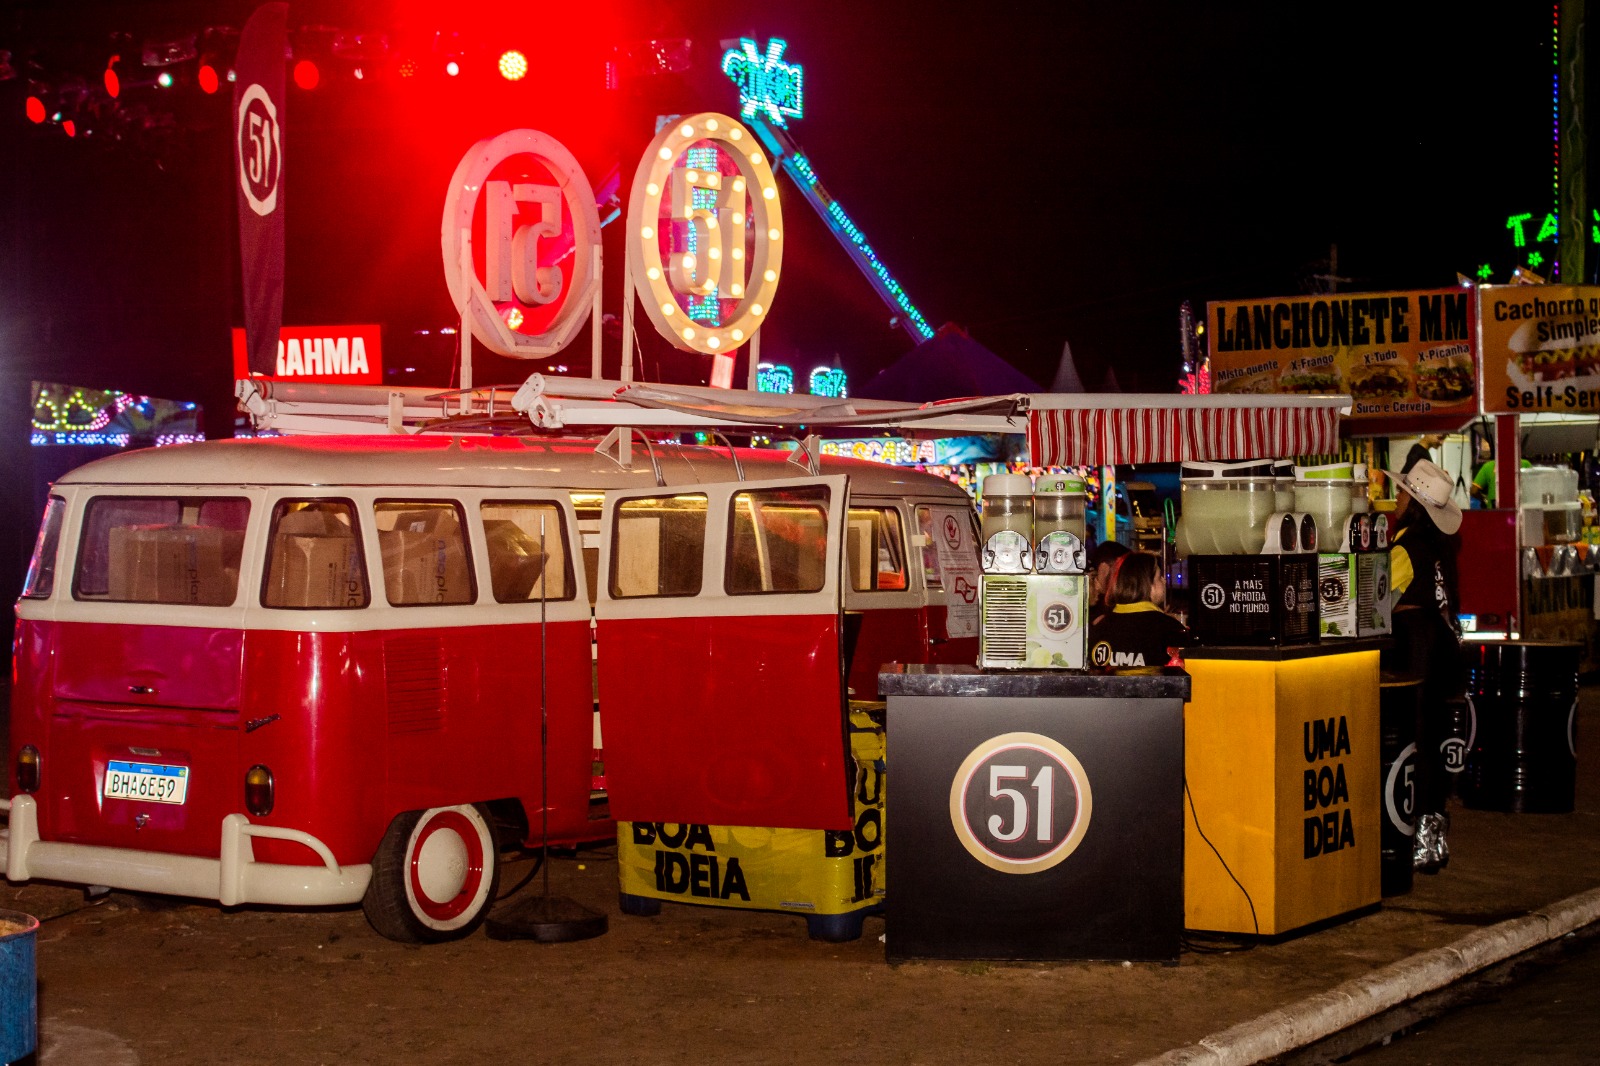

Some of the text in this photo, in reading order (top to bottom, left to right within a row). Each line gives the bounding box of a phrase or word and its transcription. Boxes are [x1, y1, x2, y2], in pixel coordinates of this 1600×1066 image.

[249, 111, 272, 188] 51
[669, 167, 746, 299] 51
[1494, 297, 1585, 321] Cachorro
[1216, 293, 1468, 353] LANCHONETE MM
[1536, 315, 1600, 343] Simple
[1290, 354, 1335, 372] X-Frango
[1363, 350, 1398, 365] X-Tudo
[1418, 344, 1470, 362] X-Picanha
[1217, 360, 1279, 381] Misto quente
[1356, 401, 1431, 414] Suco e Cerveja
[1506, 385, 1600, 409] Self-Ser
[1207, 589, 1219, 604] 51
[1232, 591, 1267, 602] VENDIDA
[1235, 580, 1263, 590] A MAIS
[1323, 582, 1340, 598] 51
[1047, 609, 1067, 626] 51
[1229, 603, 1270, 613] NO MUNDO
[1096, 646, 1146, 667] 51 UMA
[1303, 715, 1351, 763] UMA
[1446, 745, 1463, 765] 51
[111, 773, 176, 800] BHA6E59
[1303, 763, 1349, 812] BOA
[1403, 764, 1415, 815] 5
[987, 765, 1055, 843] 51
[631, 821, 716, 851] BOA
[1303, 808, 1356, 860] IDEIA
[653, 850, 751, 902] IDEIA
